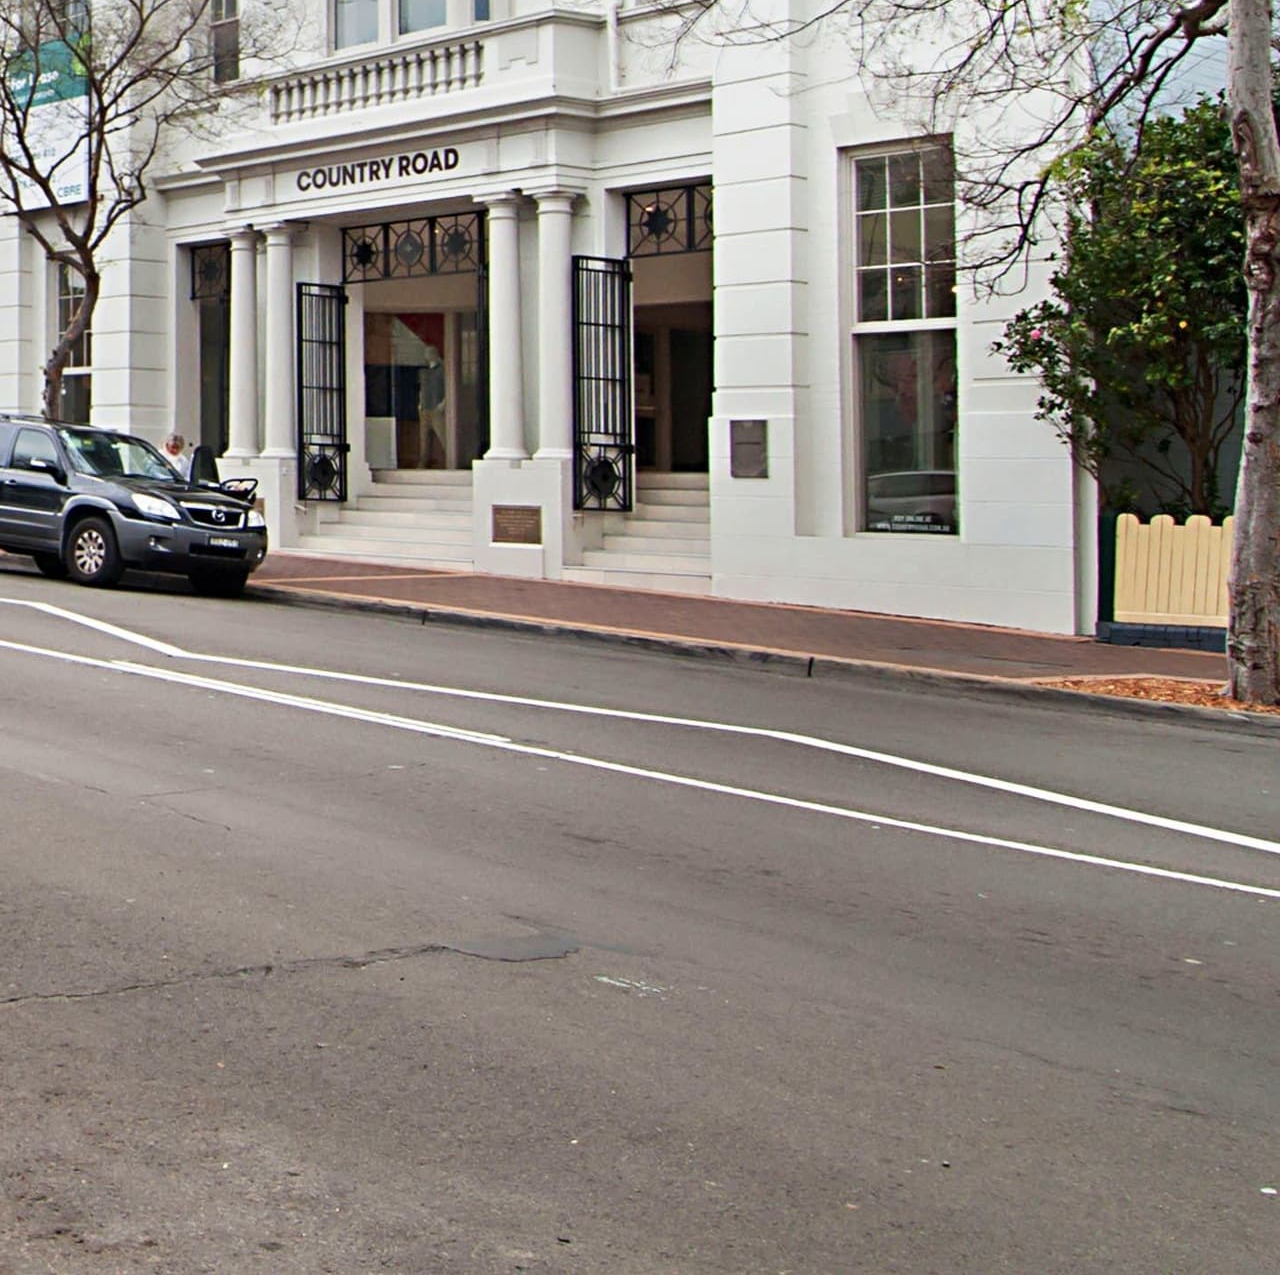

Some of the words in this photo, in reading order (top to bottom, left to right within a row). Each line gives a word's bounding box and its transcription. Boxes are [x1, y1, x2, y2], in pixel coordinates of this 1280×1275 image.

[296, 157, 394, 191] COUNTRY
[398, 148, 459, 177] ROAD
[57, 183, 82, 198] CBRE
